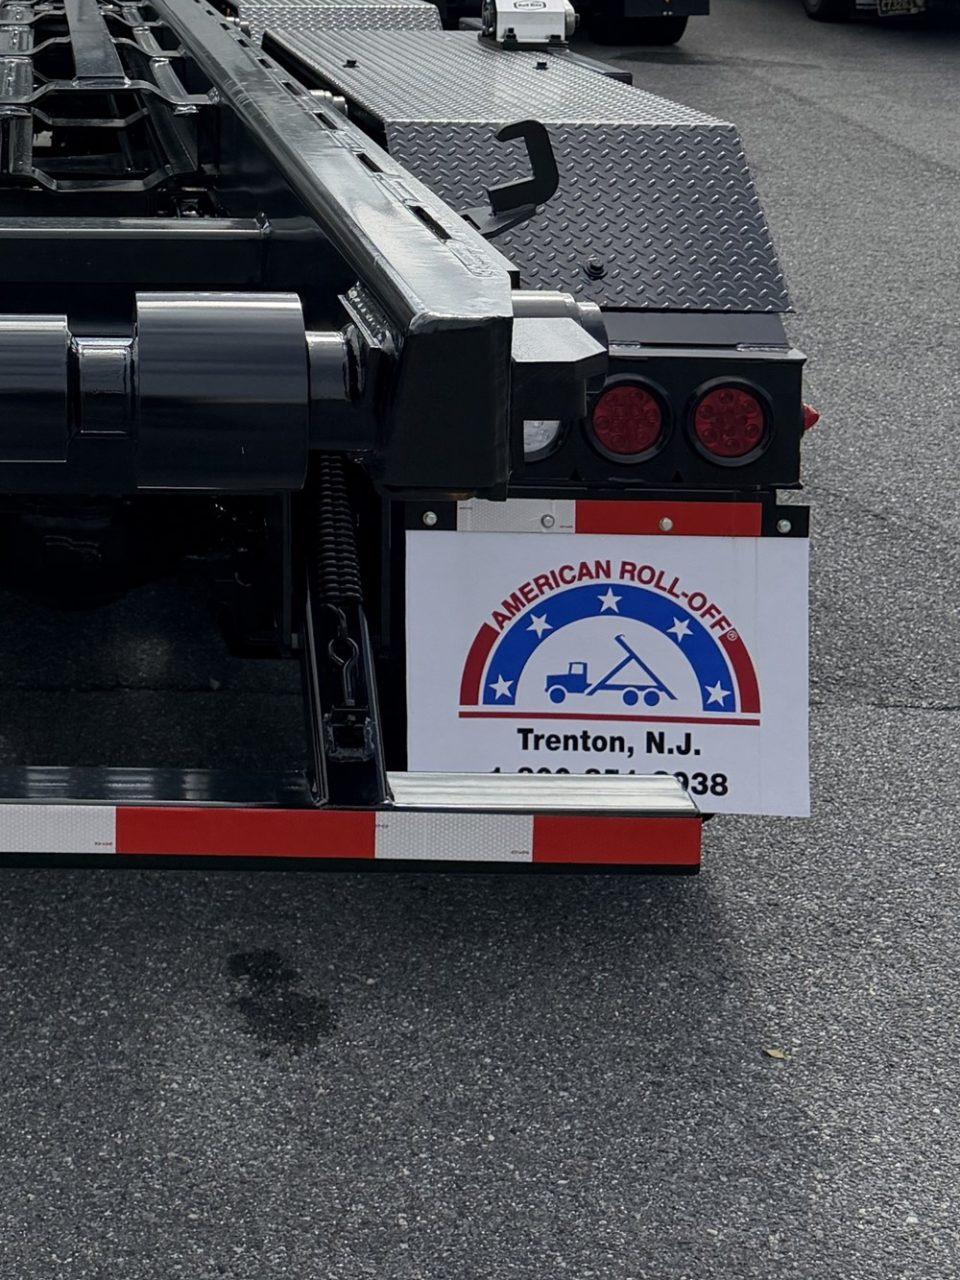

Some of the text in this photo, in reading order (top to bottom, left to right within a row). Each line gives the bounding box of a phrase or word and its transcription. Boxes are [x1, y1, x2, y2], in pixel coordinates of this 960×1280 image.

[491, 560, 611, 630] AMERICAN
[517, 728, 702, 758] Trenton, N.J.
